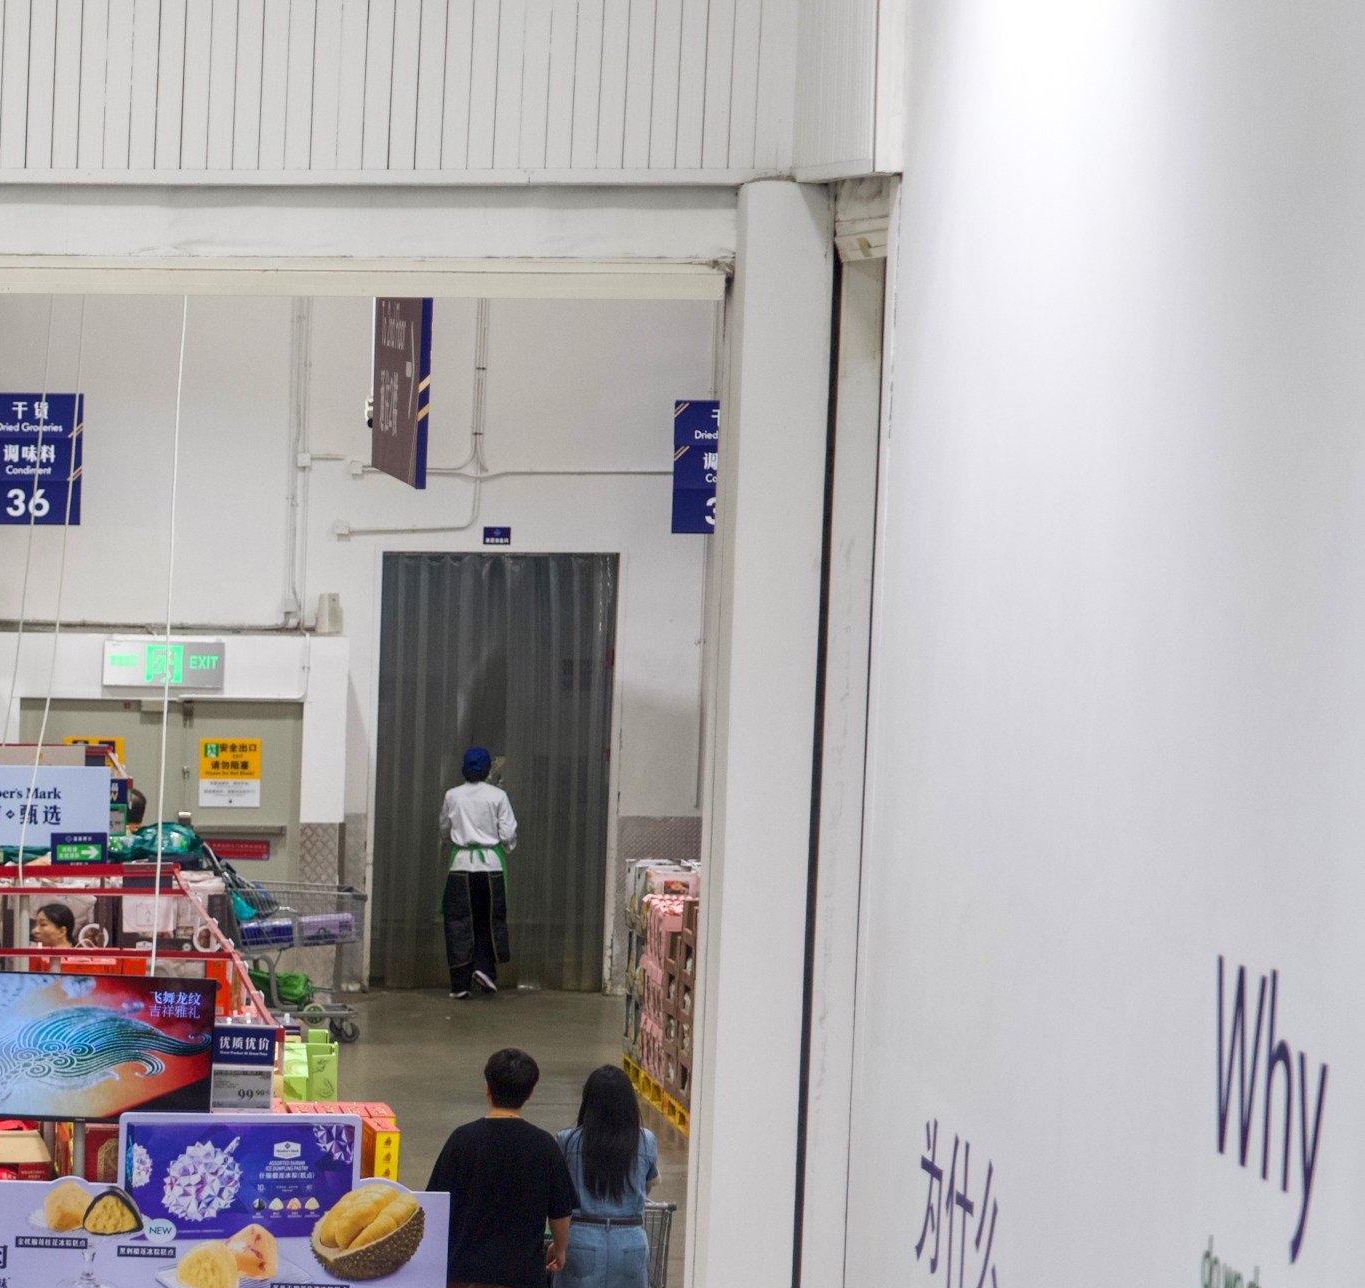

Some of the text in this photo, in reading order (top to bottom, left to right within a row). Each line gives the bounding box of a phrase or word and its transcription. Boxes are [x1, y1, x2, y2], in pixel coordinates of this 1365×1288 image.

[21, 422, 63, 433] Groeries
[694, 430, 718, 440] Dried
[3, 444, 56, 463] 调味料
[6, 488, 50, 517] 36
[189, 655, 218, 670] EXIT
[219, 743, 257, 752] 安全出口
[26, 787, 62, 800] Mark
[19, 803, 62, 826] 甄选
[153, 991, 201, 1006] 飞舞龙纹
[150, 1005, 201, 1020] 吉祥雅礼
[219, 1035, 271, 1053] 优质优价
[1215, 953, 1331, 1265] Why
[149, 1225, 172, 1236] NEW
